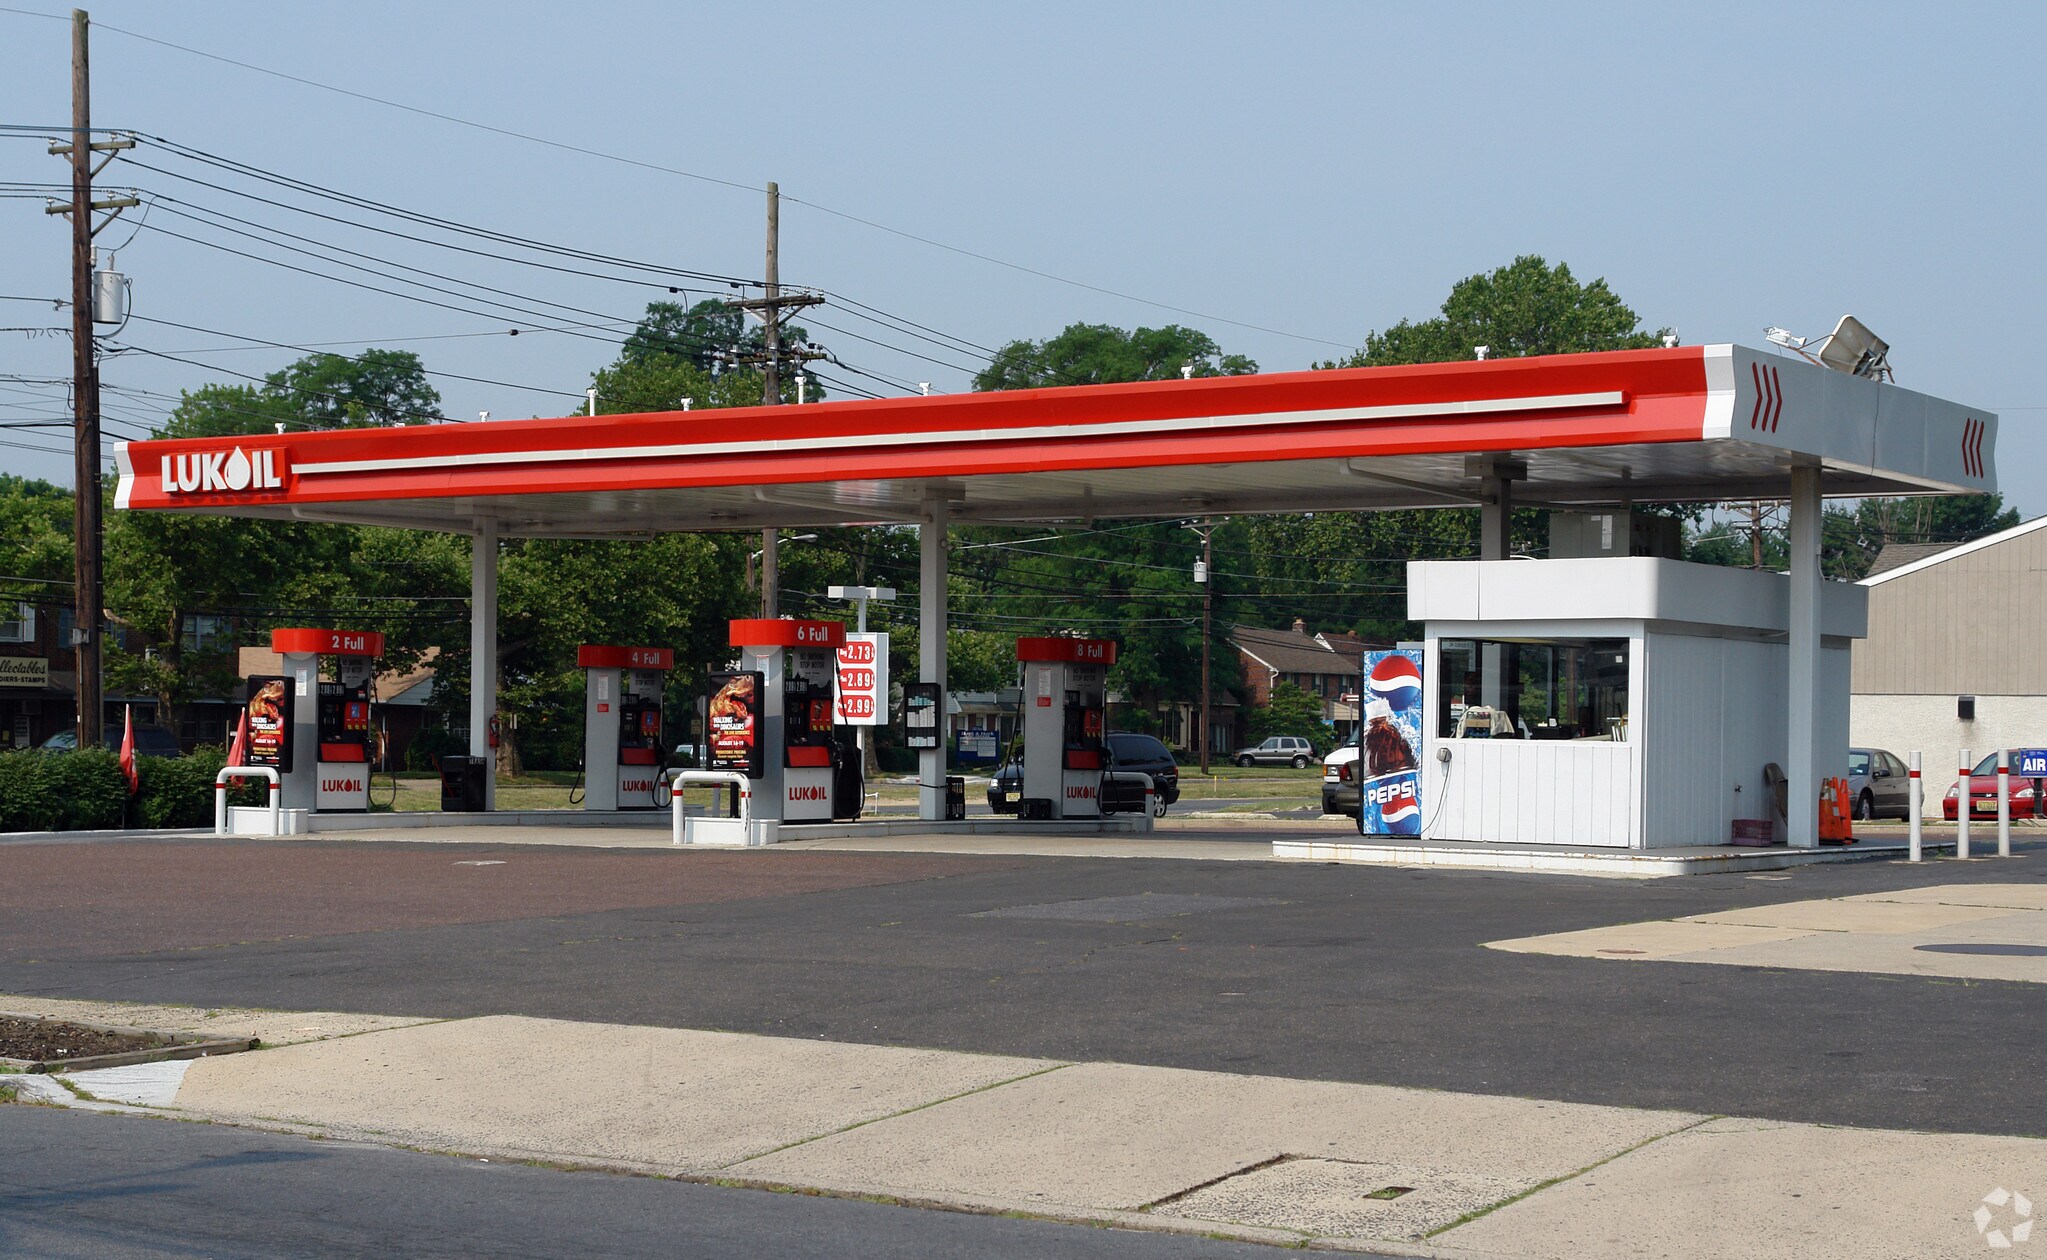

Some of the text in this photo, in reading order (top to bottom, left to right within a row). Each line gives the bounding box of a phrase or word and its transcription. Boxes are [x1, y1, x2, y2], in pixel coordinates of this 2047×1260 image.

[161, 446, 281, 493] LUKOIL
[797, 626, 828, 641] 6 Full
[332, 635, 364, 650] 2 Full
[632, 652, 659, 664] 4 Full
[848, 645, 870, 660] 2.73
[1077, 644, 1102, 658] 8 Full
[848, 672, 870, 687] 2.89
[848, 699, 870, 713] 2.99
[713, 716, 732, 724] WALKING
[720, 723, 744, 731] DINOSAURS
[2022, 758, 2047, 772] AIR
[322, 778, 362, 792] LUKOIL
[622, 779, 654, 792] LUKOIL
[1066, 785, 1096, 799] LUKOIL
[789, 785, 827, 801] LUKOIL
[1367, 780, 1416, 807] PEPSI
